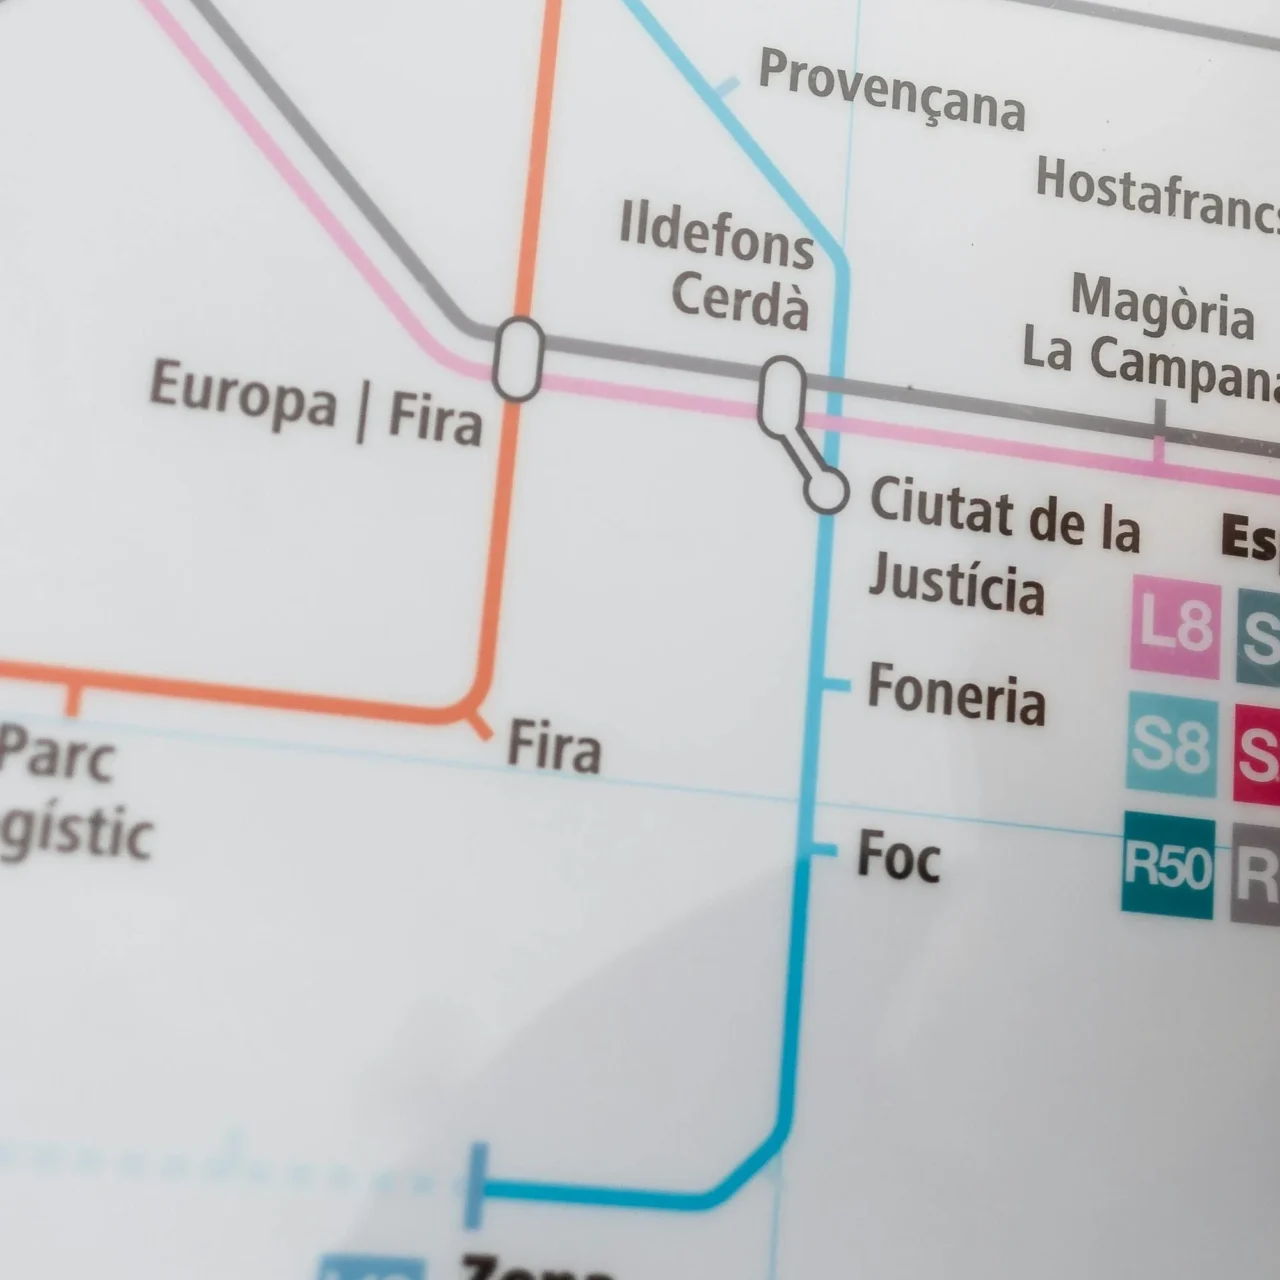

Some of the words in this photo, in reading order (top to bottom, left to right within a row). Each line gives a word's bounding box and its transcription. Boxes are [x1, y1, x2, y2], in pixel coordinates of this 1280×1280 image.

[759, 46, 1027, 133] Provençana
[619, 198, 815, 270] Ildefons
[672, 270, 810, 332] Cerdà
[1072, 272, 1255, 340] Magòria
[1023, 323, 1073, 371] La
[150, 358, 338, 433] Europa
[389, 391, 484, 447] Fira
[870, 476, 1014, 537] Ciutat
[1029, 495, 1086, 547] de
[1102, 503, 1141, 554] la
[868, 550, 1046, 617] Justícia
[1140, 592, 1214, 653] L8
[867, 661, 1047, 727] Foneria
[0, 724, 116, 784] Parc
[508, 718, 602, 775] Fira
[1131, 714, 1211, 776] S8
[857, 829, 941, 885] Foc
[1125, 838, 1213, 892] R50
